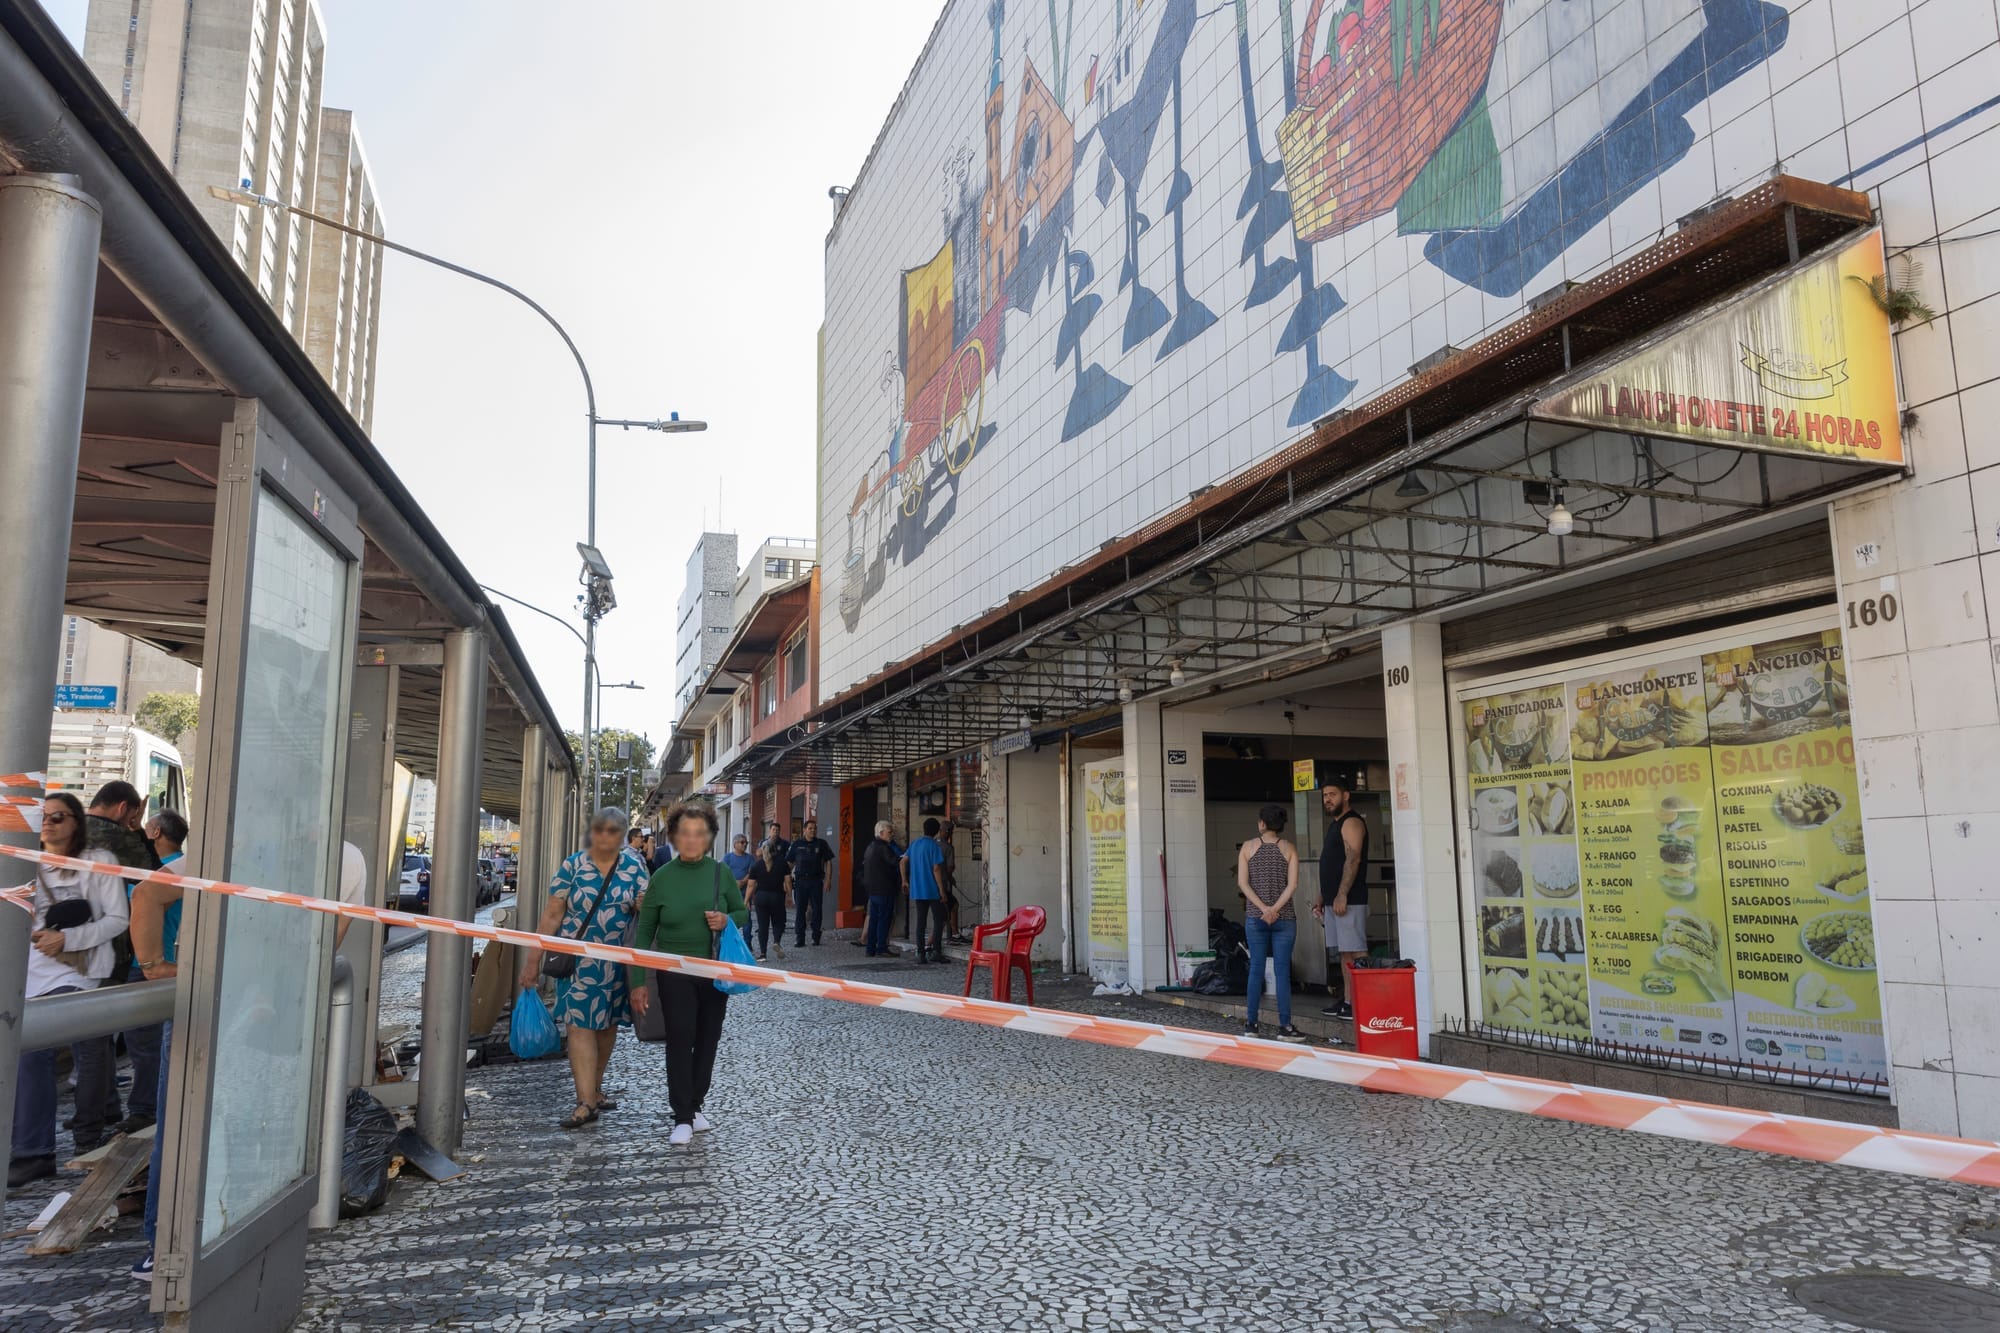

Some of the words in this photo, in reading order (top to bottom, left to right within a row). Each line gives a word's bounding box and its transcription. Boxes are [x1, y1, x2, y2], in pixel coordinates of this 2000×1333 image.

[1600, 383, 1767, 436] LANCHONETE
[1773, 407, 1800, 439] 24
[1805, 411, 1882, 449] HORAS
[1847, 594, 1897, 629] 160
[1734, 645, 1843, 678] LANCHONE
[1387, 665, 1409, 687] 160
[1592, 671, 1698, 701] LANCHONETE
[1751, 674, 1822, 705] Cana
[1484, 696, 1564, 719] PANIFICADORA
[1606, 699, 1660, 725] Cana
[1000, 735, 1023, 752] LOTERIAS
[1473, 774, 1489, 784] PÃES
[1490, 772, 1532, 783] QUENTINHOS
[1583, 761, 1701, 791] PROMOÇÕES
[1721, 785, 1772, 797] COXINHA
[1581, 801, 1587, 809] X
[1595, 798, 1630, 808] SALADA
[1722, 805, 1745, 815] KIBE
[1583, 827, 1589, 835] X
[1597, 825, 1632, 834] SALADA
[1724, 822, 1762, 833] PASTEL
[1726, 840, 1767, 851] RISOLIS
[1585, 852, 1591, 860] X
[1599, 851, 1636, 860] FRANGO
[1728, 859, 1776, 869] BOLINHO
[1587, 878, 1593, 886] X
[1601, 878, 1632, 887] BACON
[1729, 877, 1789, 887] ESPETINHO
[1732, 896, 1791, 906] SALGADOS
[1589, 904, 1595, 913] X
[1603, 905, 1622, 913] EGG
[1733, 915, 1799, 925] EMPADINHA
[1591, 931, 1597, 939] X
[1605, 931, 1659, 942] CALABRESA
[1735, 933, 1775, 943] SONHO
[1593, 957, 1599, 965] X
[1608, 958, 1631, 967] TUDO
[1737, 951, 1803, 964] BRIGADEIRO
[1738, 970, 1789, 982] BOMBOM
[1600, 997, 1652, 1012] ACEITAMOS
[1655, 1000, 1723, 1019] ENCOMENDAS
[1747, 1011, 1814, 1029] ACEITAMOS
